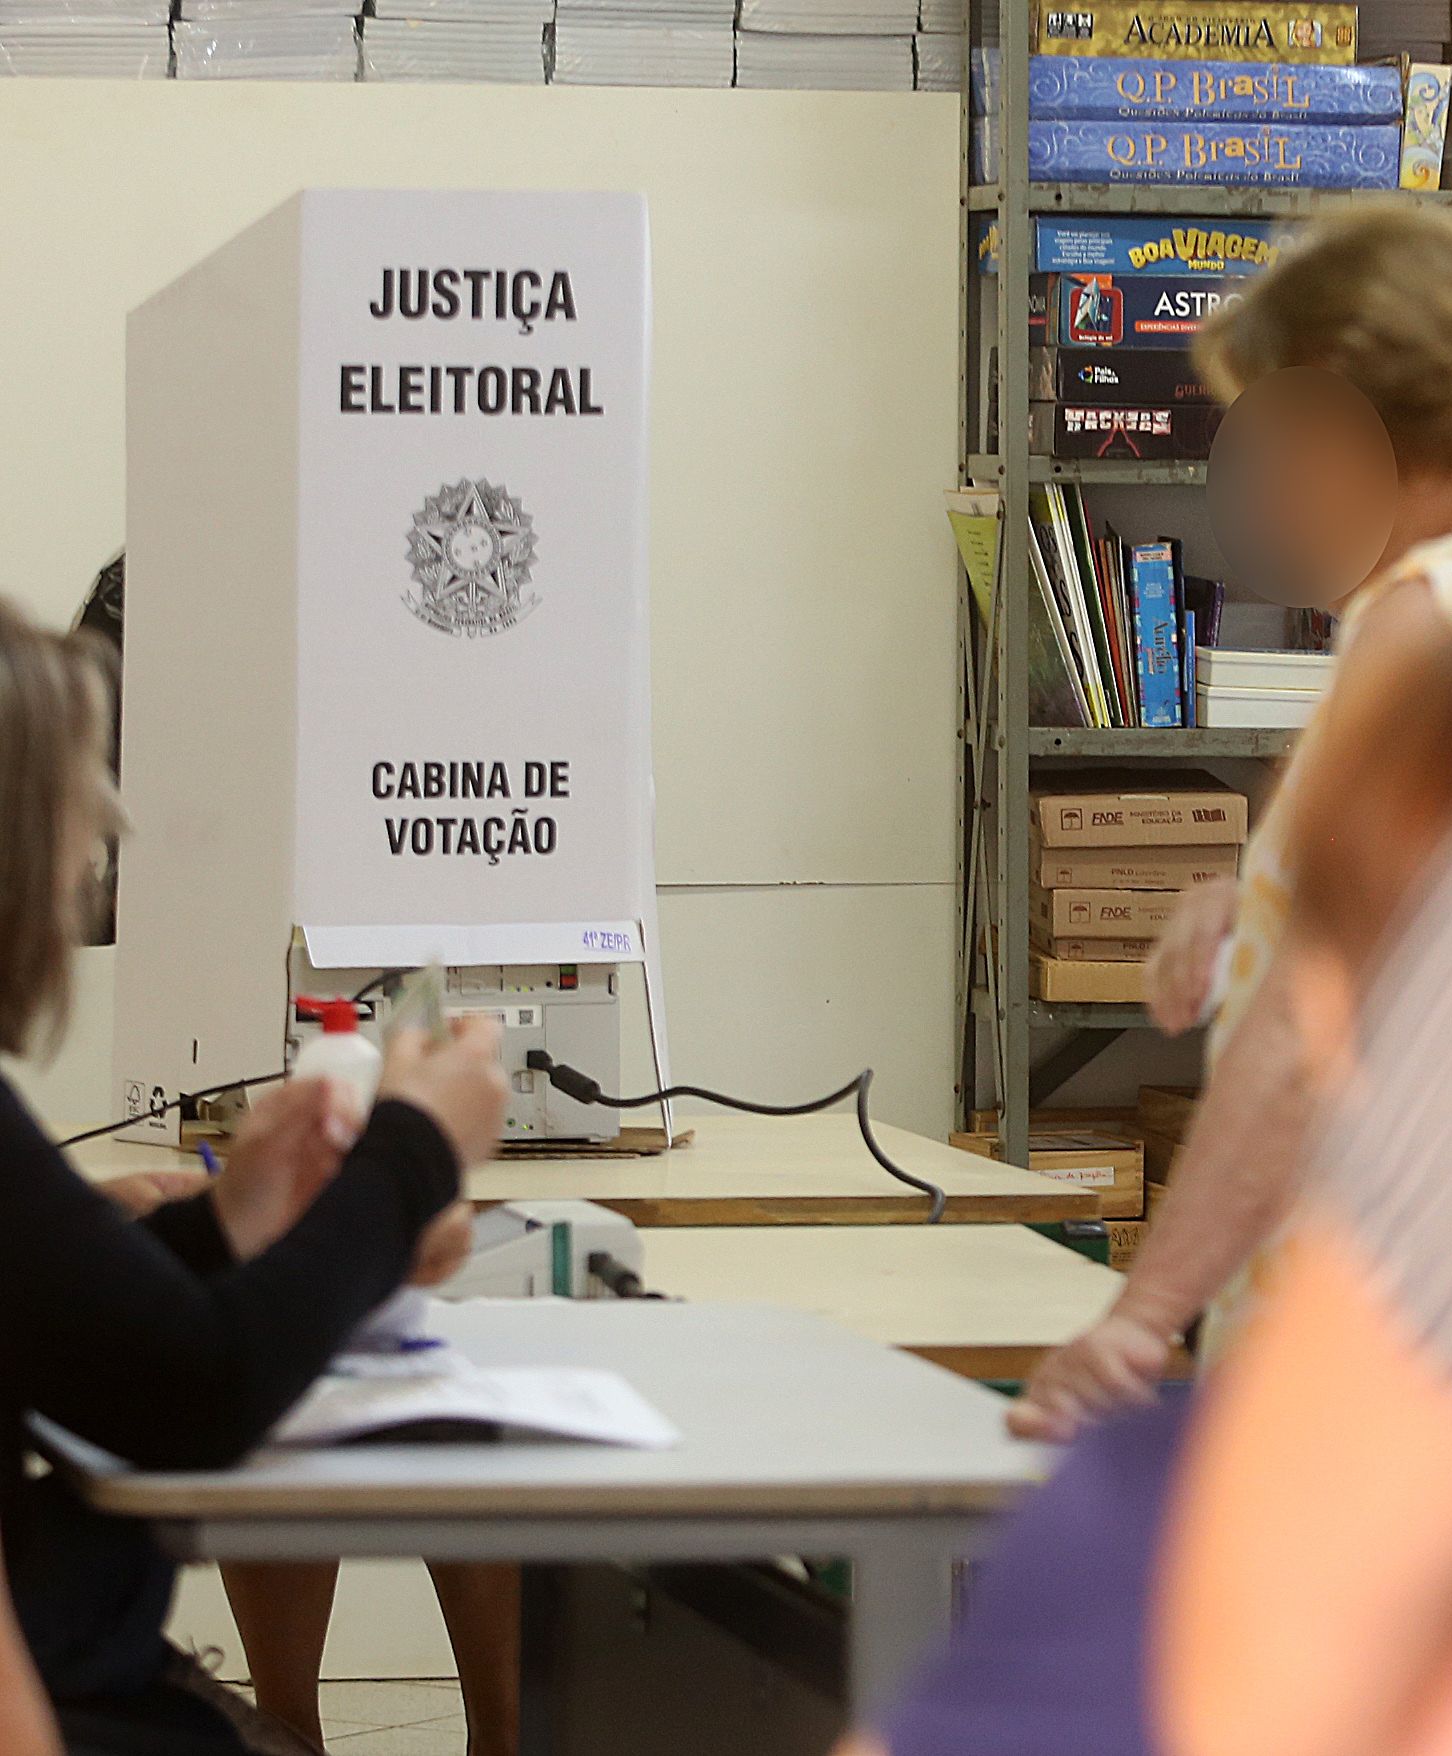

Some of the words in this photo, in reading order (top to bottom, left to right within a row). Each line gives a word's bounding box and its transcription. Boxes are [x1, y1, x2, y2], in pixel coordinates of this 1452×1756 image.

[1124, 13, 1275, 47] ACADEMIA
[1116, 71, 1177, 104] Q.P.
[1107, 134, 1168, 166] Q.P.
[1128, 238, 1175, 269] BOA
[1172, 228, 1280, 268] VIAGEM
[1188, 259, 1226, 271] MUNDO
[369, 268, 578, 335] JUSTIÇA
[1095, 366, 1111, 376] Pais
[1095, 374, 1119, 384] Filhos
[340, 365, 605, 416] ELEITORAL
[372, 761, 512, 800] CABINA
[524, 761, 571, 799] DE
[385, 807, 558, 866] VOTAÇÃO
